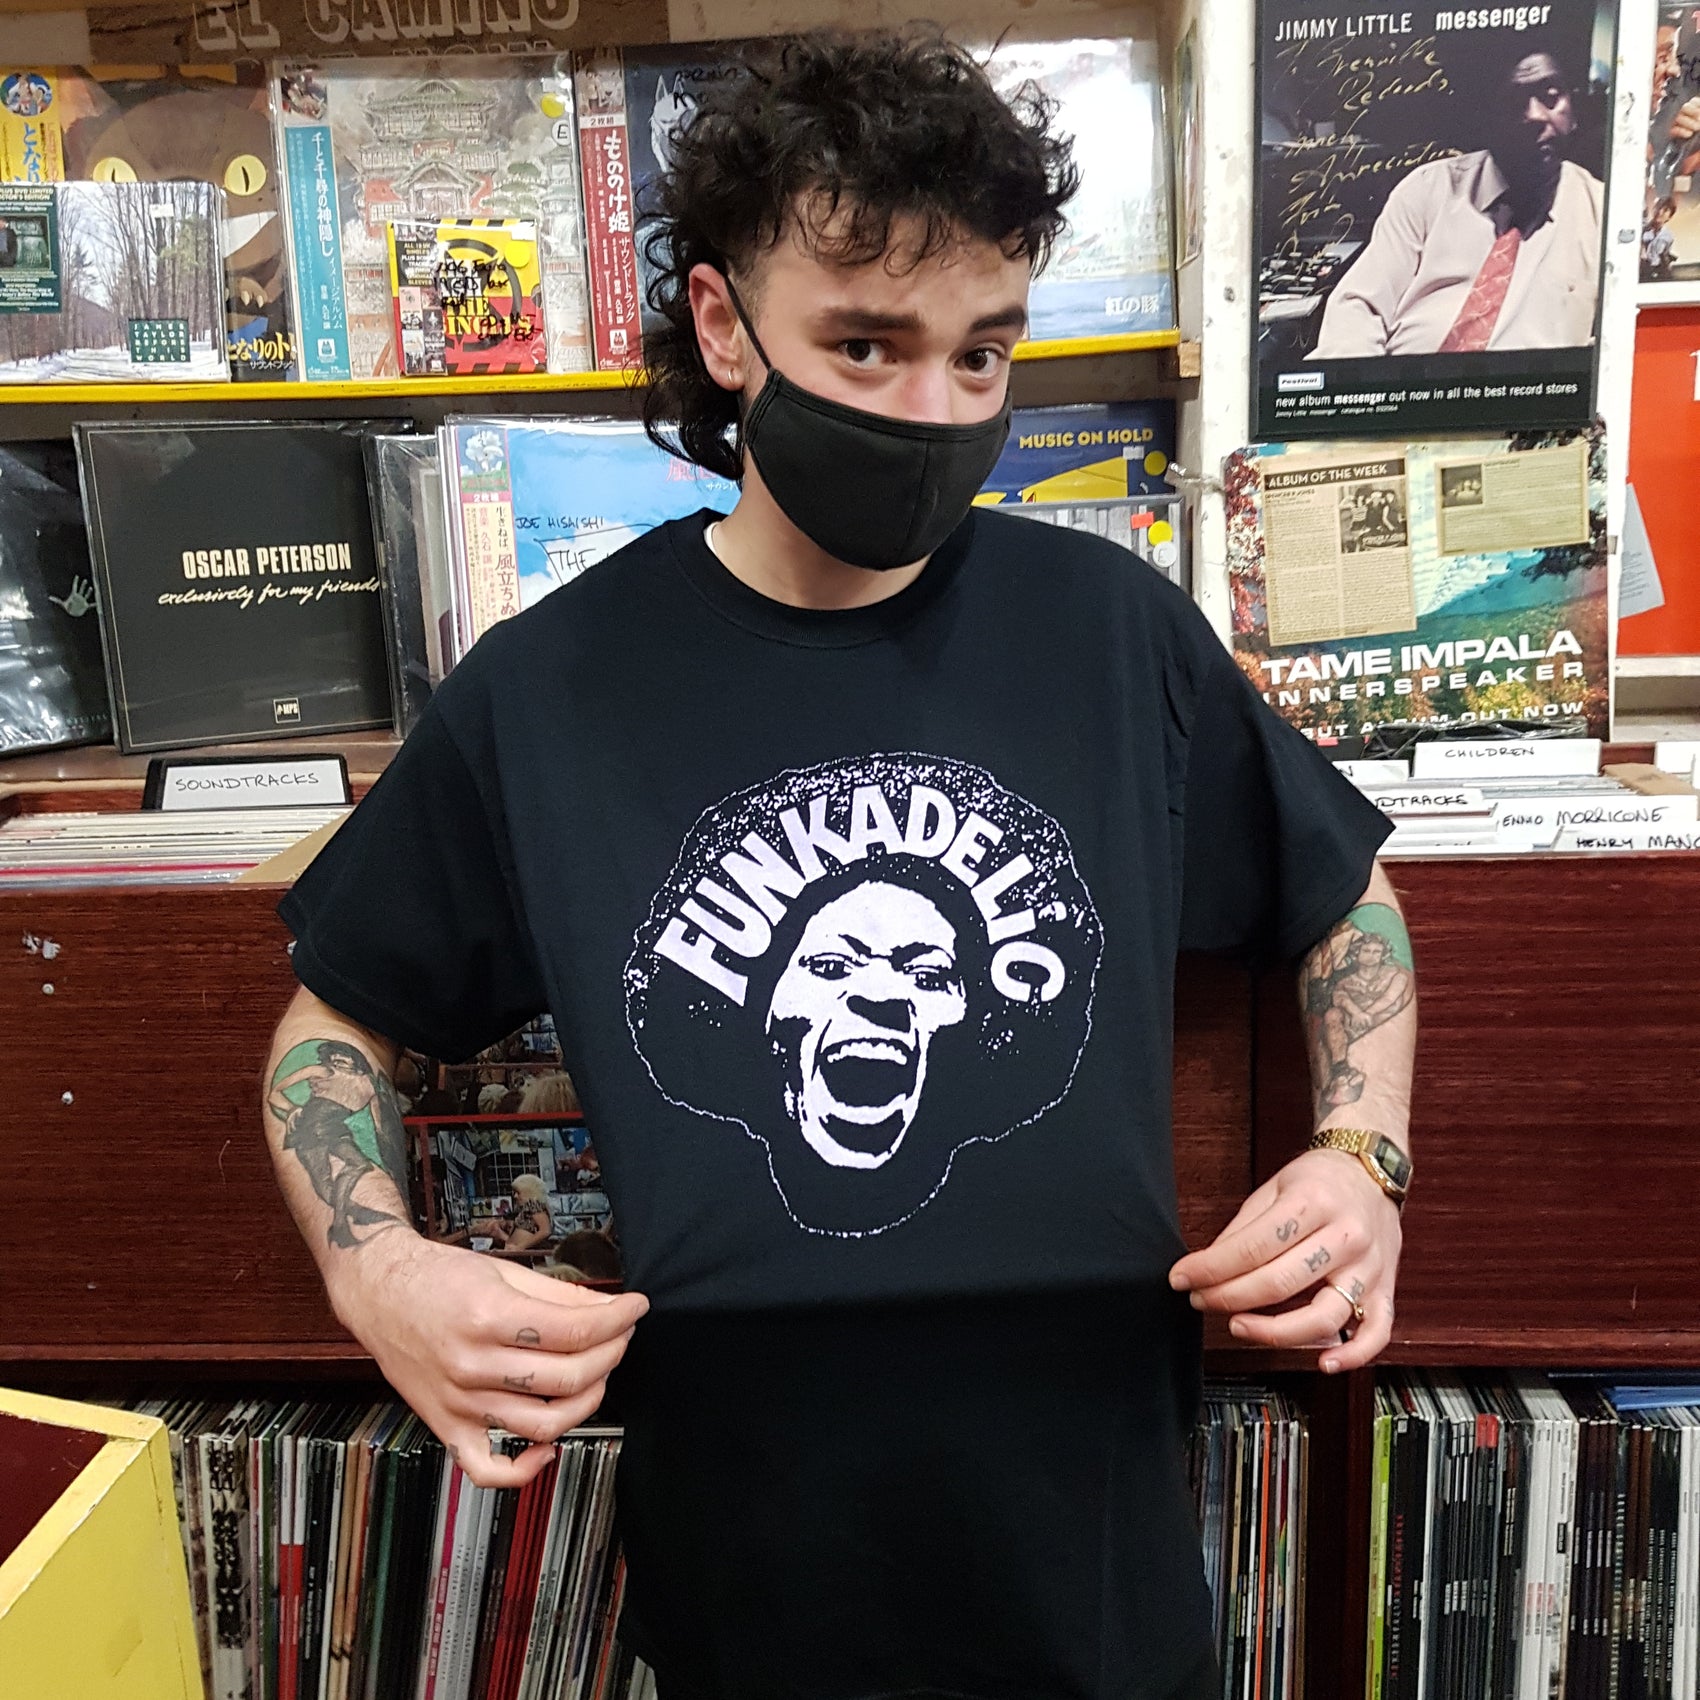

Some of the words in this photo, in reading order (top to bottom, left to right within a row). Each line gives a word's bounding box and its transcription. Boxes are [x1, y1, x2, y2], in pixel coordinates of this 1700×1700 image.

[1275, 17, 1338, 42] JIMMY
[1346, 12, 1413, 37] LITTLE
[1436, 4, 1551, 31] messenger
[311, 131, 334, 257] 千と千尋の神隠し
[603, 129, 631, 234] もののけ姫
[1276, 397, 1296, 408] new
[1299, 395, 1331, 407] album
[1334, 392, 1387, 406] messenger
[1389, 390, 1406, 402] out
[1409, 390, 1430, 401] now
[1434, 388, 1444, 400] in
[1447, 387, 1460, 399] all
[1464, 385, 1481, 398] the
[1484, 384, 1507, 398] best
[1509, 382, 1543, 396] record
[1545, 382, 1578, 395] stores
[1019, 431, 1075, 450] MUSIC
[1077, 429, 1103, 446] ON
[1107, 427, 1154, 444] HOLD
[1268, 475, 1309, 489] ALBUM
[1310, 471, 1326, 484] OF
[1328, 468, 1352, 481] THE
[1353, 464, 1387, 478] WEEK
[516, 517, 541, 529] JOE
[183, 549, 250, 579] OSCAR
[256, 543, 351, 575] PETERSON
[158, 586, 253, 609] exclusively
[258, 583, 288, 604] for
[289, 585, 313, 605] my
[495, 554, 517, 616] 風立ちぬ
[1260, 648, 1393, 685] TAME
[1401, 630, 1583, 673] IMPALA
[1461, 708, 1511, 721] OUT
[1523, 701, 1584, 718] NOW
[1445, 747, 1534, 758] CHILDREN
[175, 773, 319, 791] SOUNDTRACKS
[1556, 806, 1669, 826] MORRICONE
[1577, 837, 1633, 849] HENRY
[654, 783, 1066, 1007] FUNKADELIC
